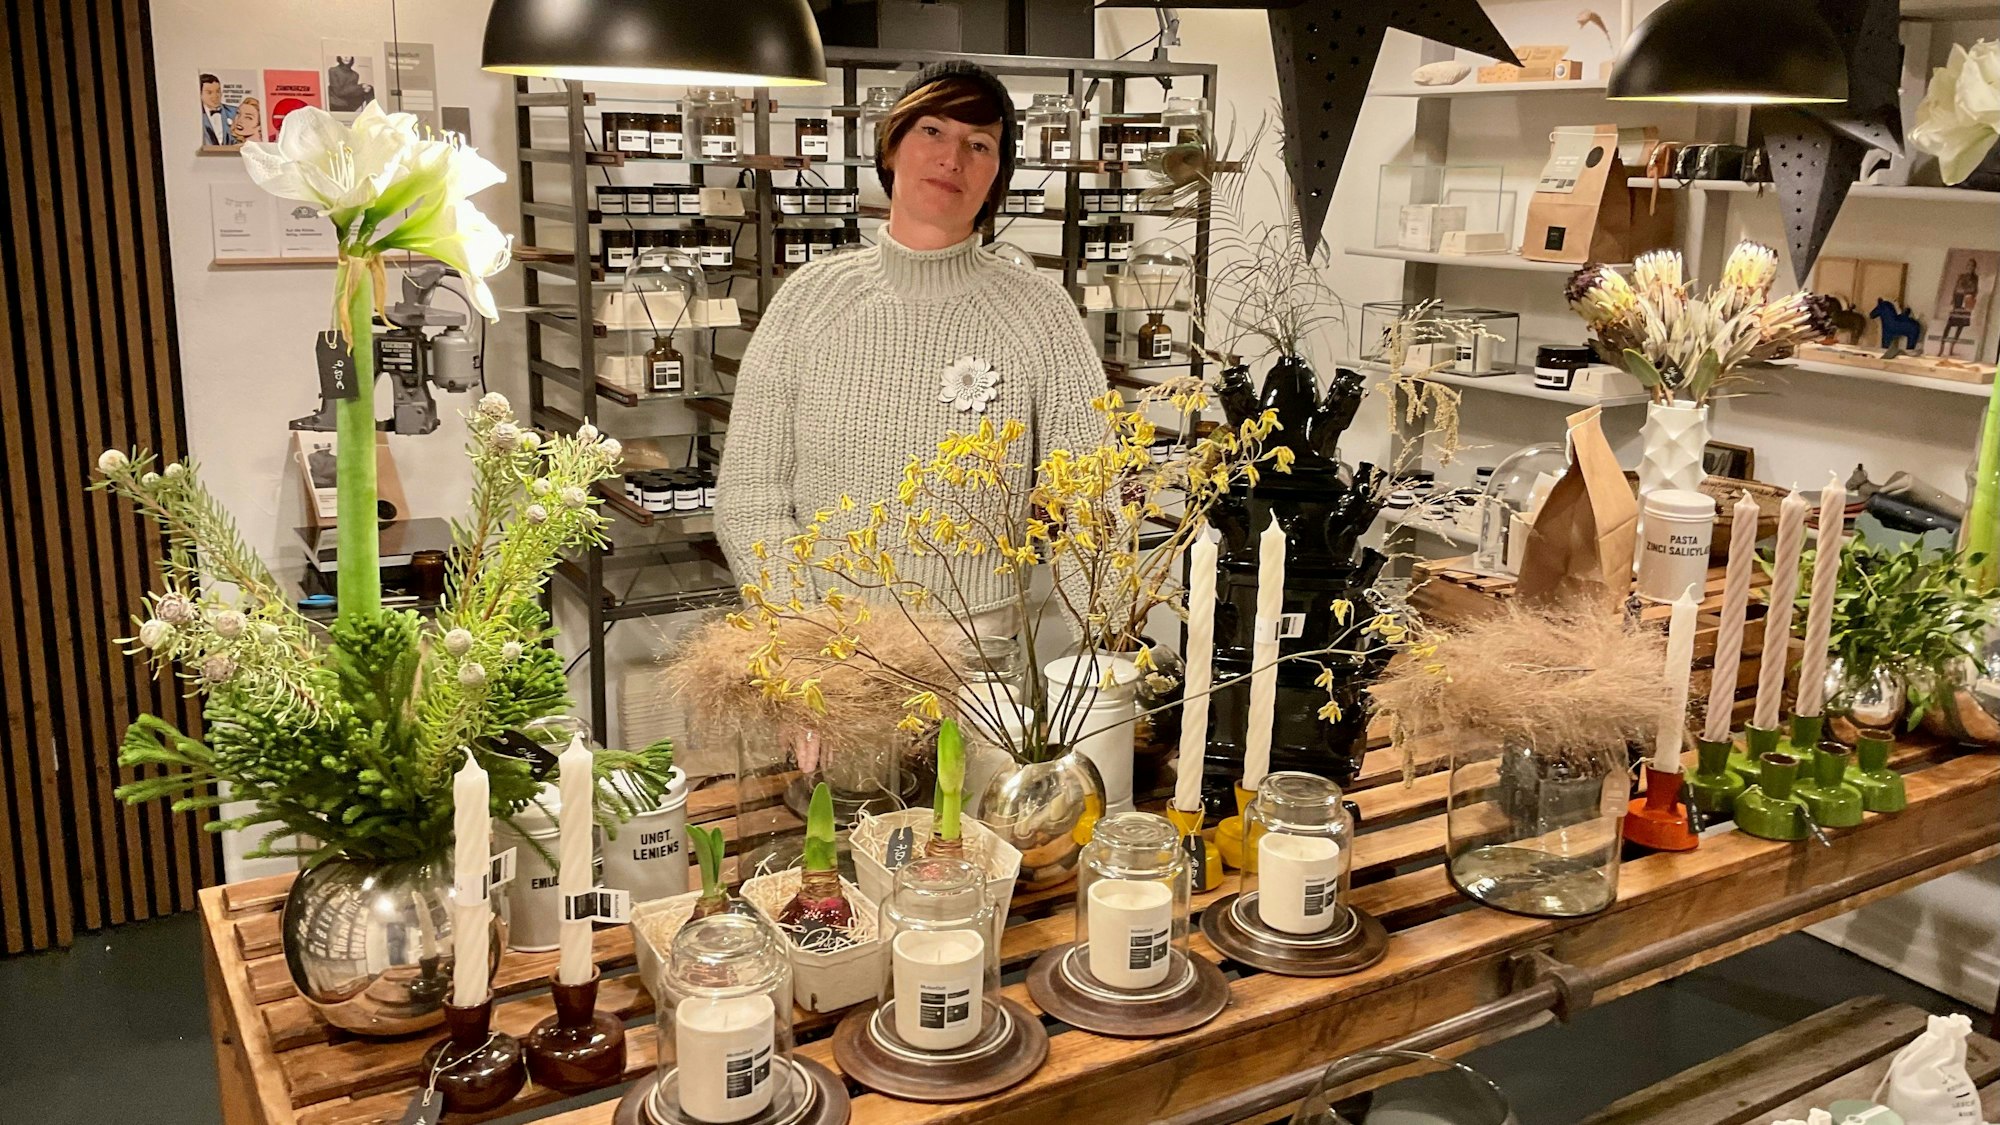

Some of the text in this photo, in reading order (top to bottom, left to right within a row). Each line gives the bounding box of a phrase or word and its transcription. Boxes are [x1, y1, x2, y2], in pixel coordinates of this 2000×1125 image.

[1670, 535, 1698, 545] PASTA
[1646, 541, 1666, 554] ZINCI
[641, 829, 673, 845] UNGT.
[633, 841, 679, 861] LENIENS
